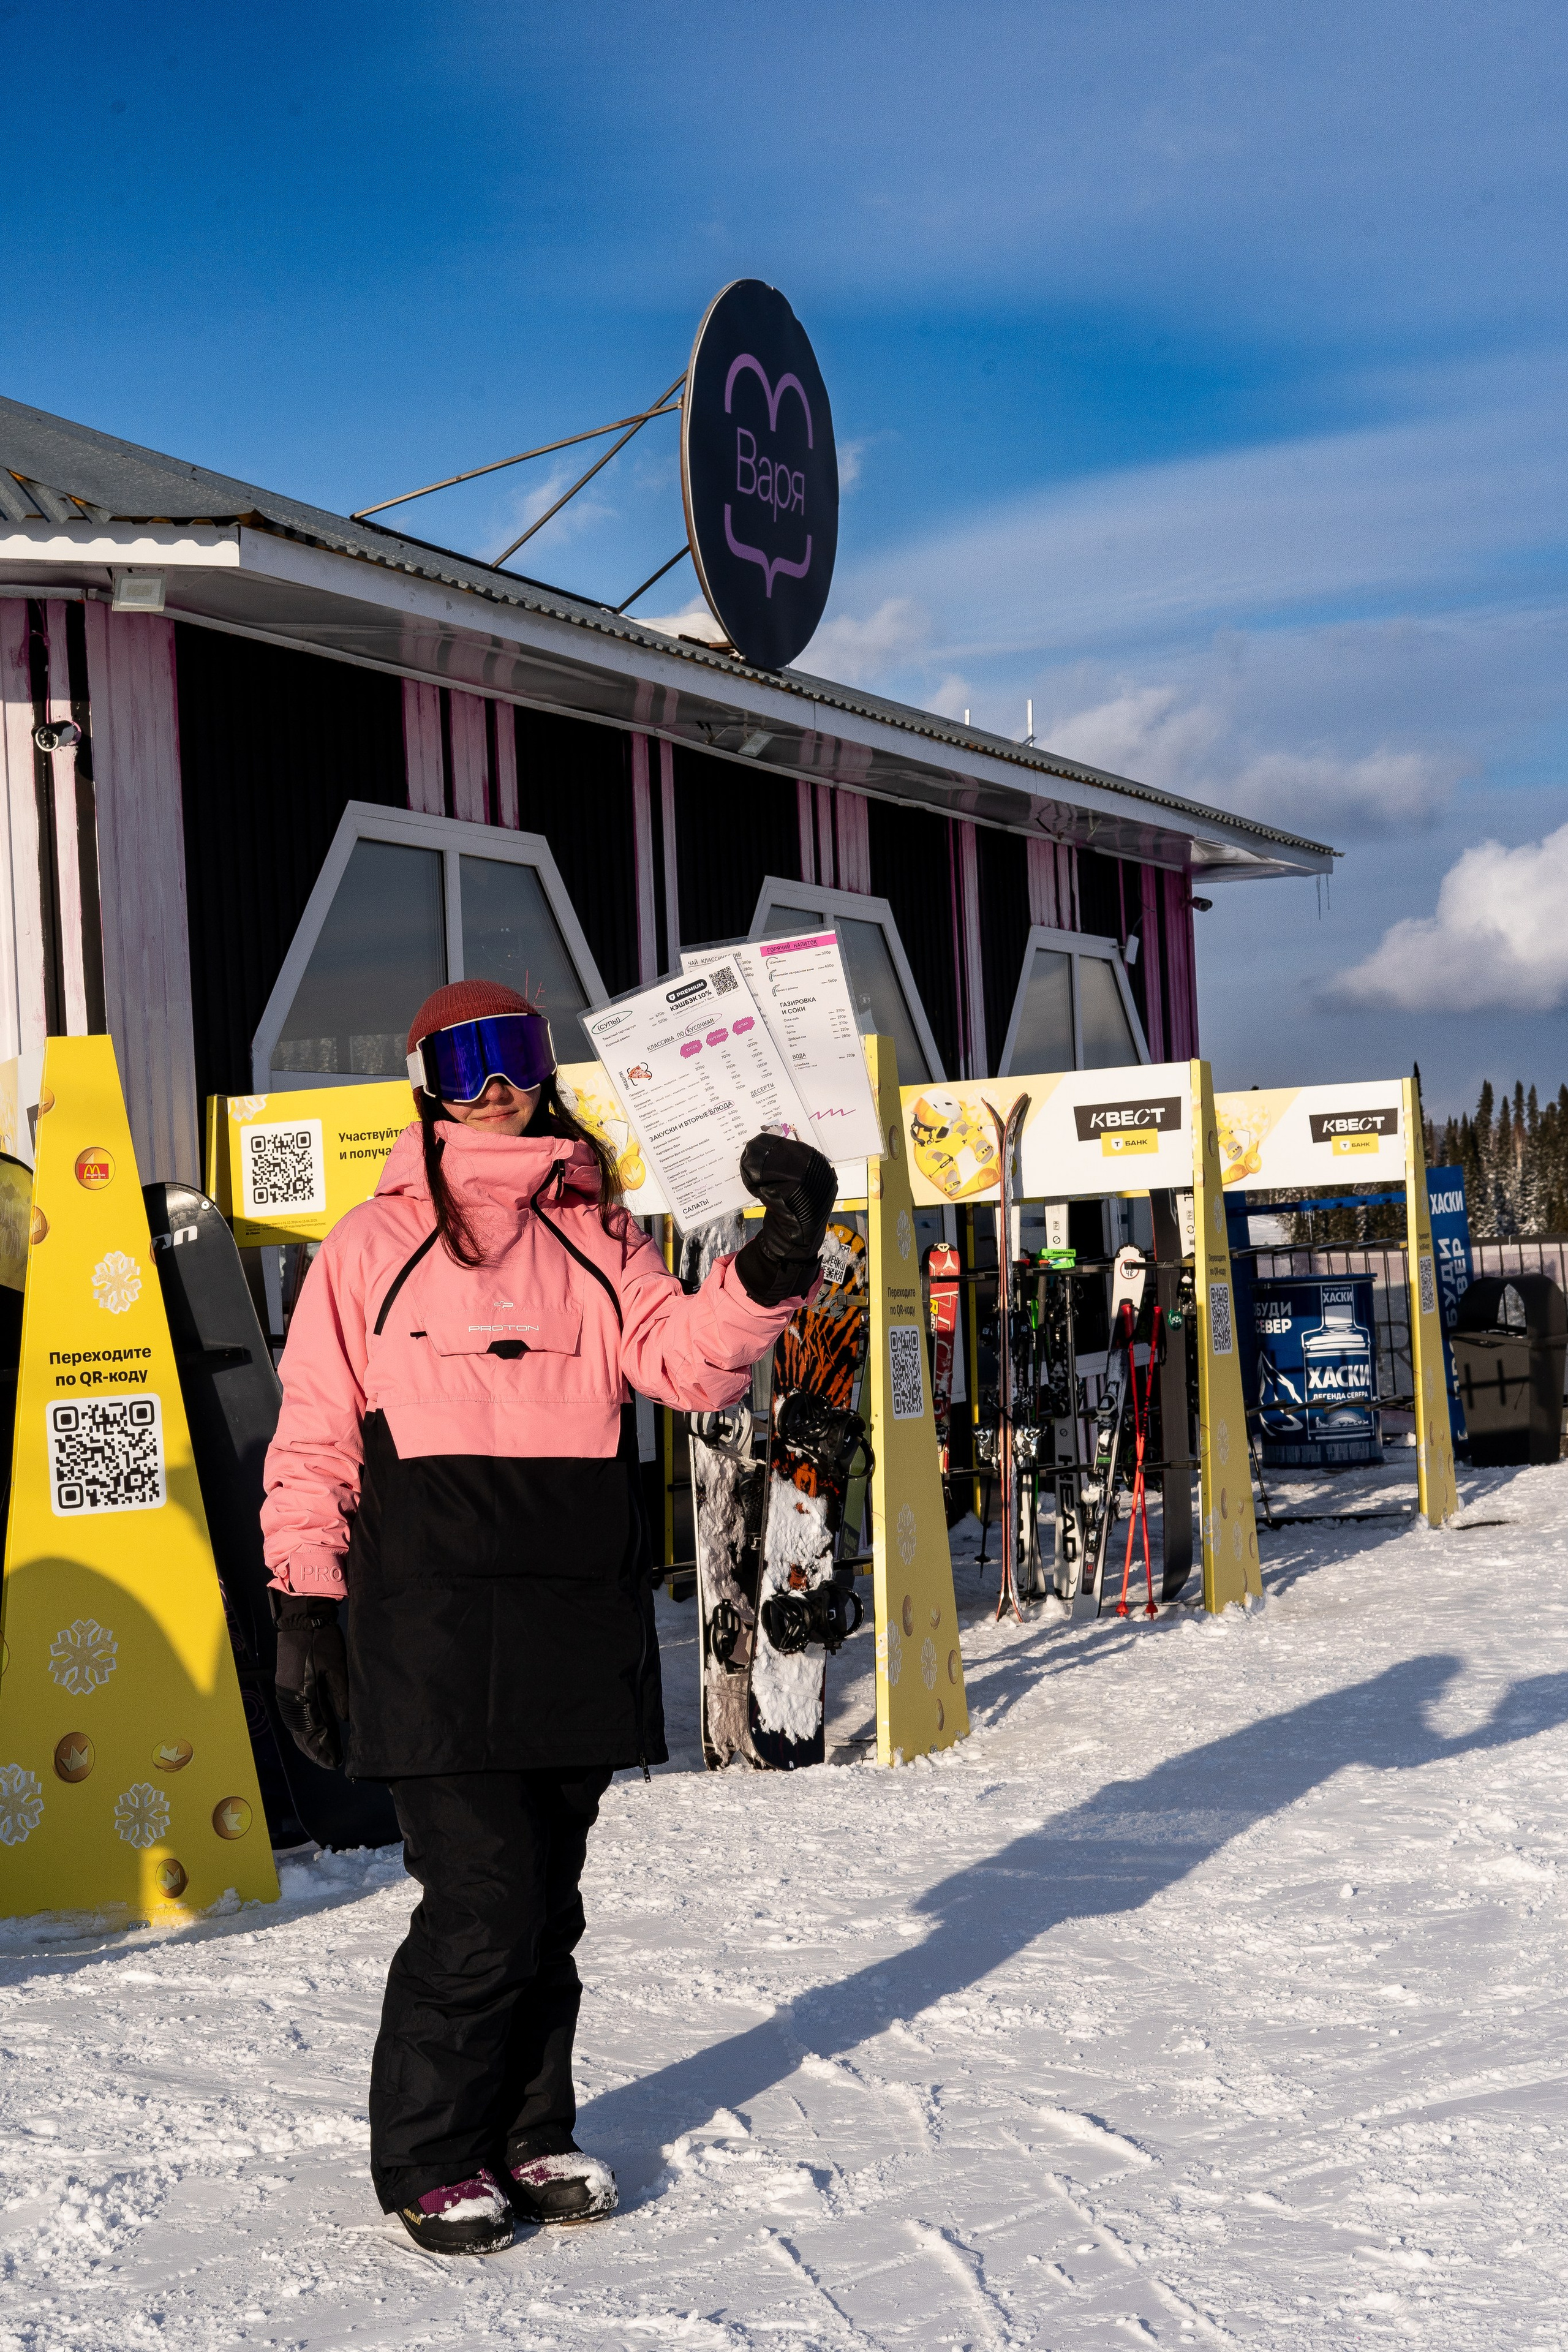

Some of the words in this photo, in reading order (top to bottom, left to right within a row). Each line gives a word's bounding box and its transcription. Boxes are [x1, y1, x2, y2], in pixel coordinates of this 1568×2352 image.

[737, 427, 804, 522] Варя
[766, 943, 791, 953] ГОРЯЧИЙ
[792, 938, 818, 949] НАПИТОК
[676, 982, 704, 997] PREMIUM
[669, 995, 698, 1011] КЭШБЭК
[698, 989, 712, 999] 10%
[780, 997, 816, 1007] ГАЗИРОВКА
[646, 1036, 674, 1051] КЛАССИКА
[685, 1017, 714, 1033] КУСОЧКАМ
[685, 1043, 699, 1052] КУСОК
[706, 1030, 728, 1043] ПОЛОВИНА
[735, 1020, 750, 1030] ЦЕЛАЯ
[750, 1082, 774, 1097] ДЕСЕРТЫ
[649, 1125, 677, 1142] ЗАКУСКИ
[684, 1111, 709, 1126] ВТОРЫЕ
[707, 1100, 734, 1115] БЛЮДА
[1090, 1107, 1166, 1128] КВЕСТ
[1322, 1117, 1385, 1133] КВЕСТ
[682, 1199, 709, 1213] САЛАТЫ
[1430, 1190, 1464, 1215] ХАСКИ
[888, 1286, 916, 1299] Переходите
[1322, 1292, 1353, 1303] ХАСКИ
[890, 1306, 896, 1315] по
[897, 1304, 915, 1317] QR-коду
[49, 1347, 151, 1366] Переходите
[56, 1374, 76, 1386] по
[80, 1370, 148, 1387] QR-коду
[1307, 1364, 1370, 1389] ХАСКИ
